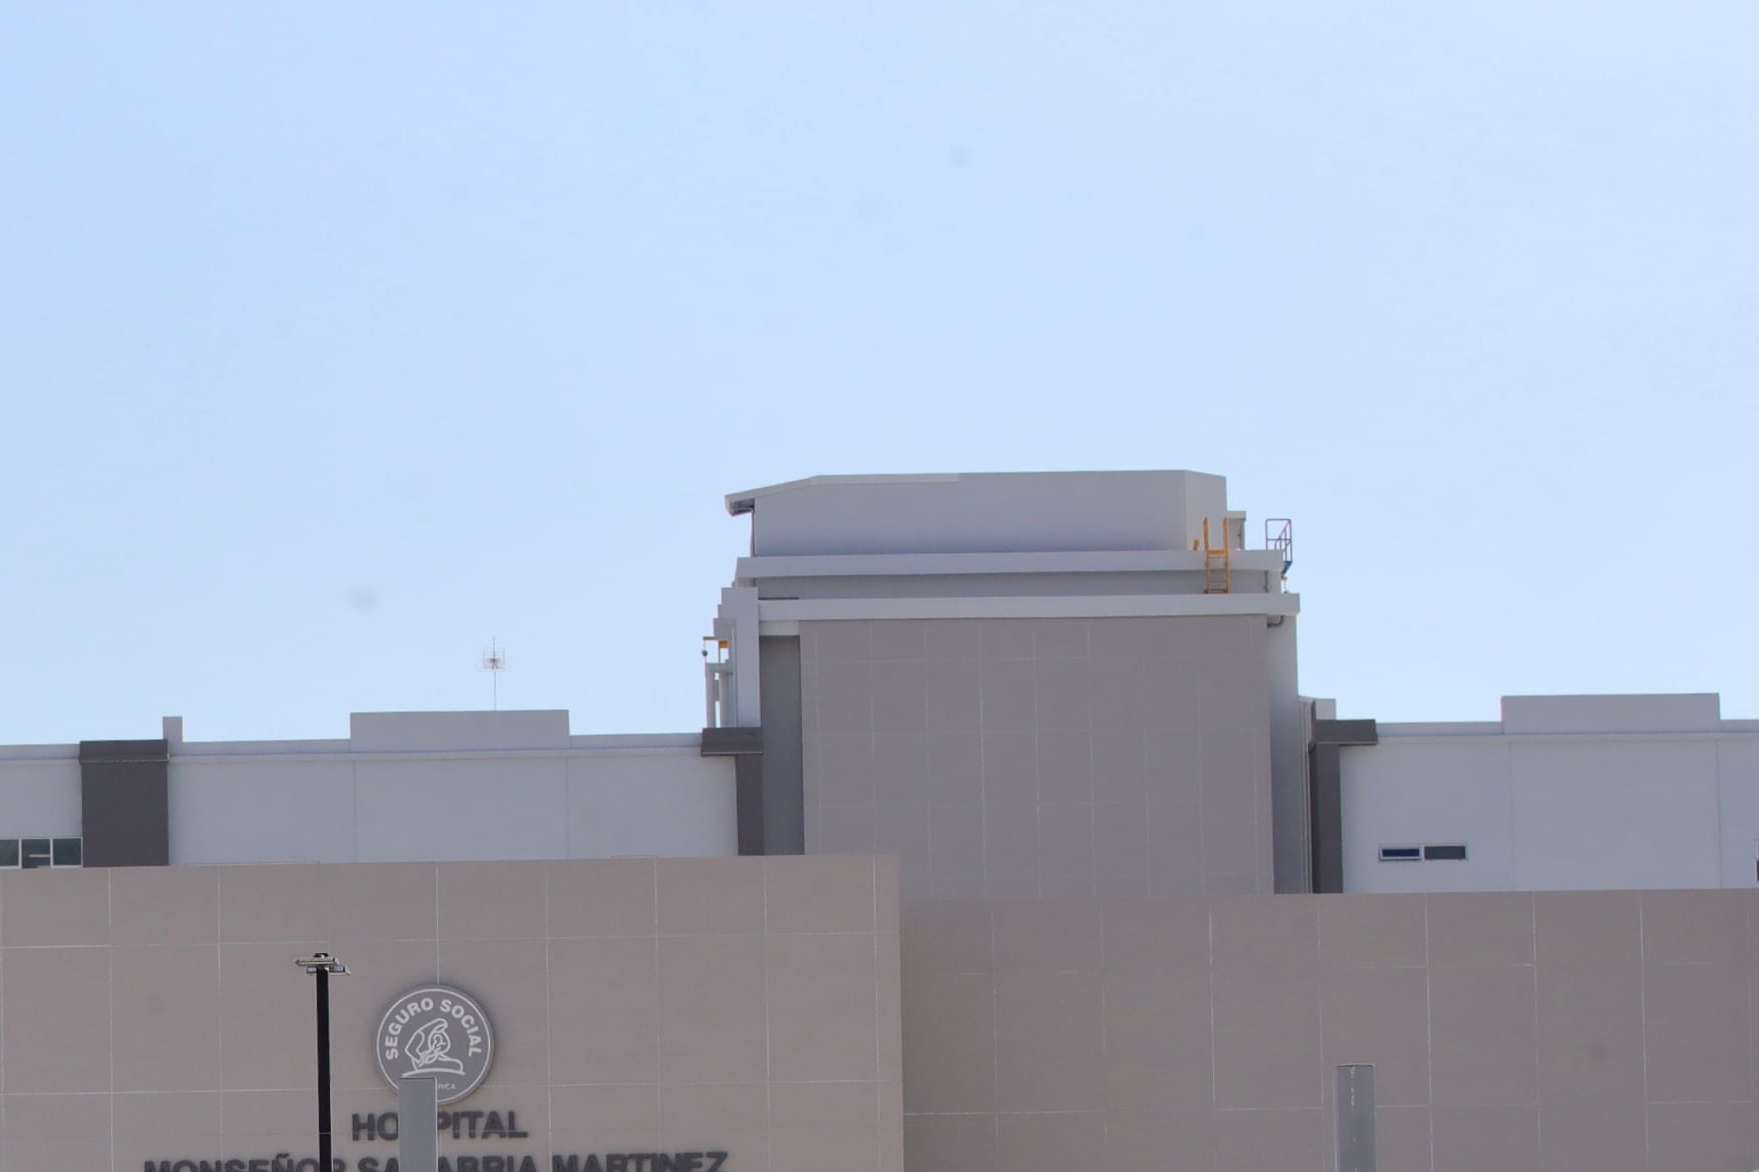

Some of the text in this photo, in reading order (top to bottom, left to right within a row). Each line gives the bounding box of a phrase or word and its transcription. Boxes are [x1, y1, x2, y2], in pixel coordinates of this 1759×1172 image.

[384, 997, 482, 1060] SEGURO SOCIAL
[351, 1110, 528, 1141] HOPITAL
